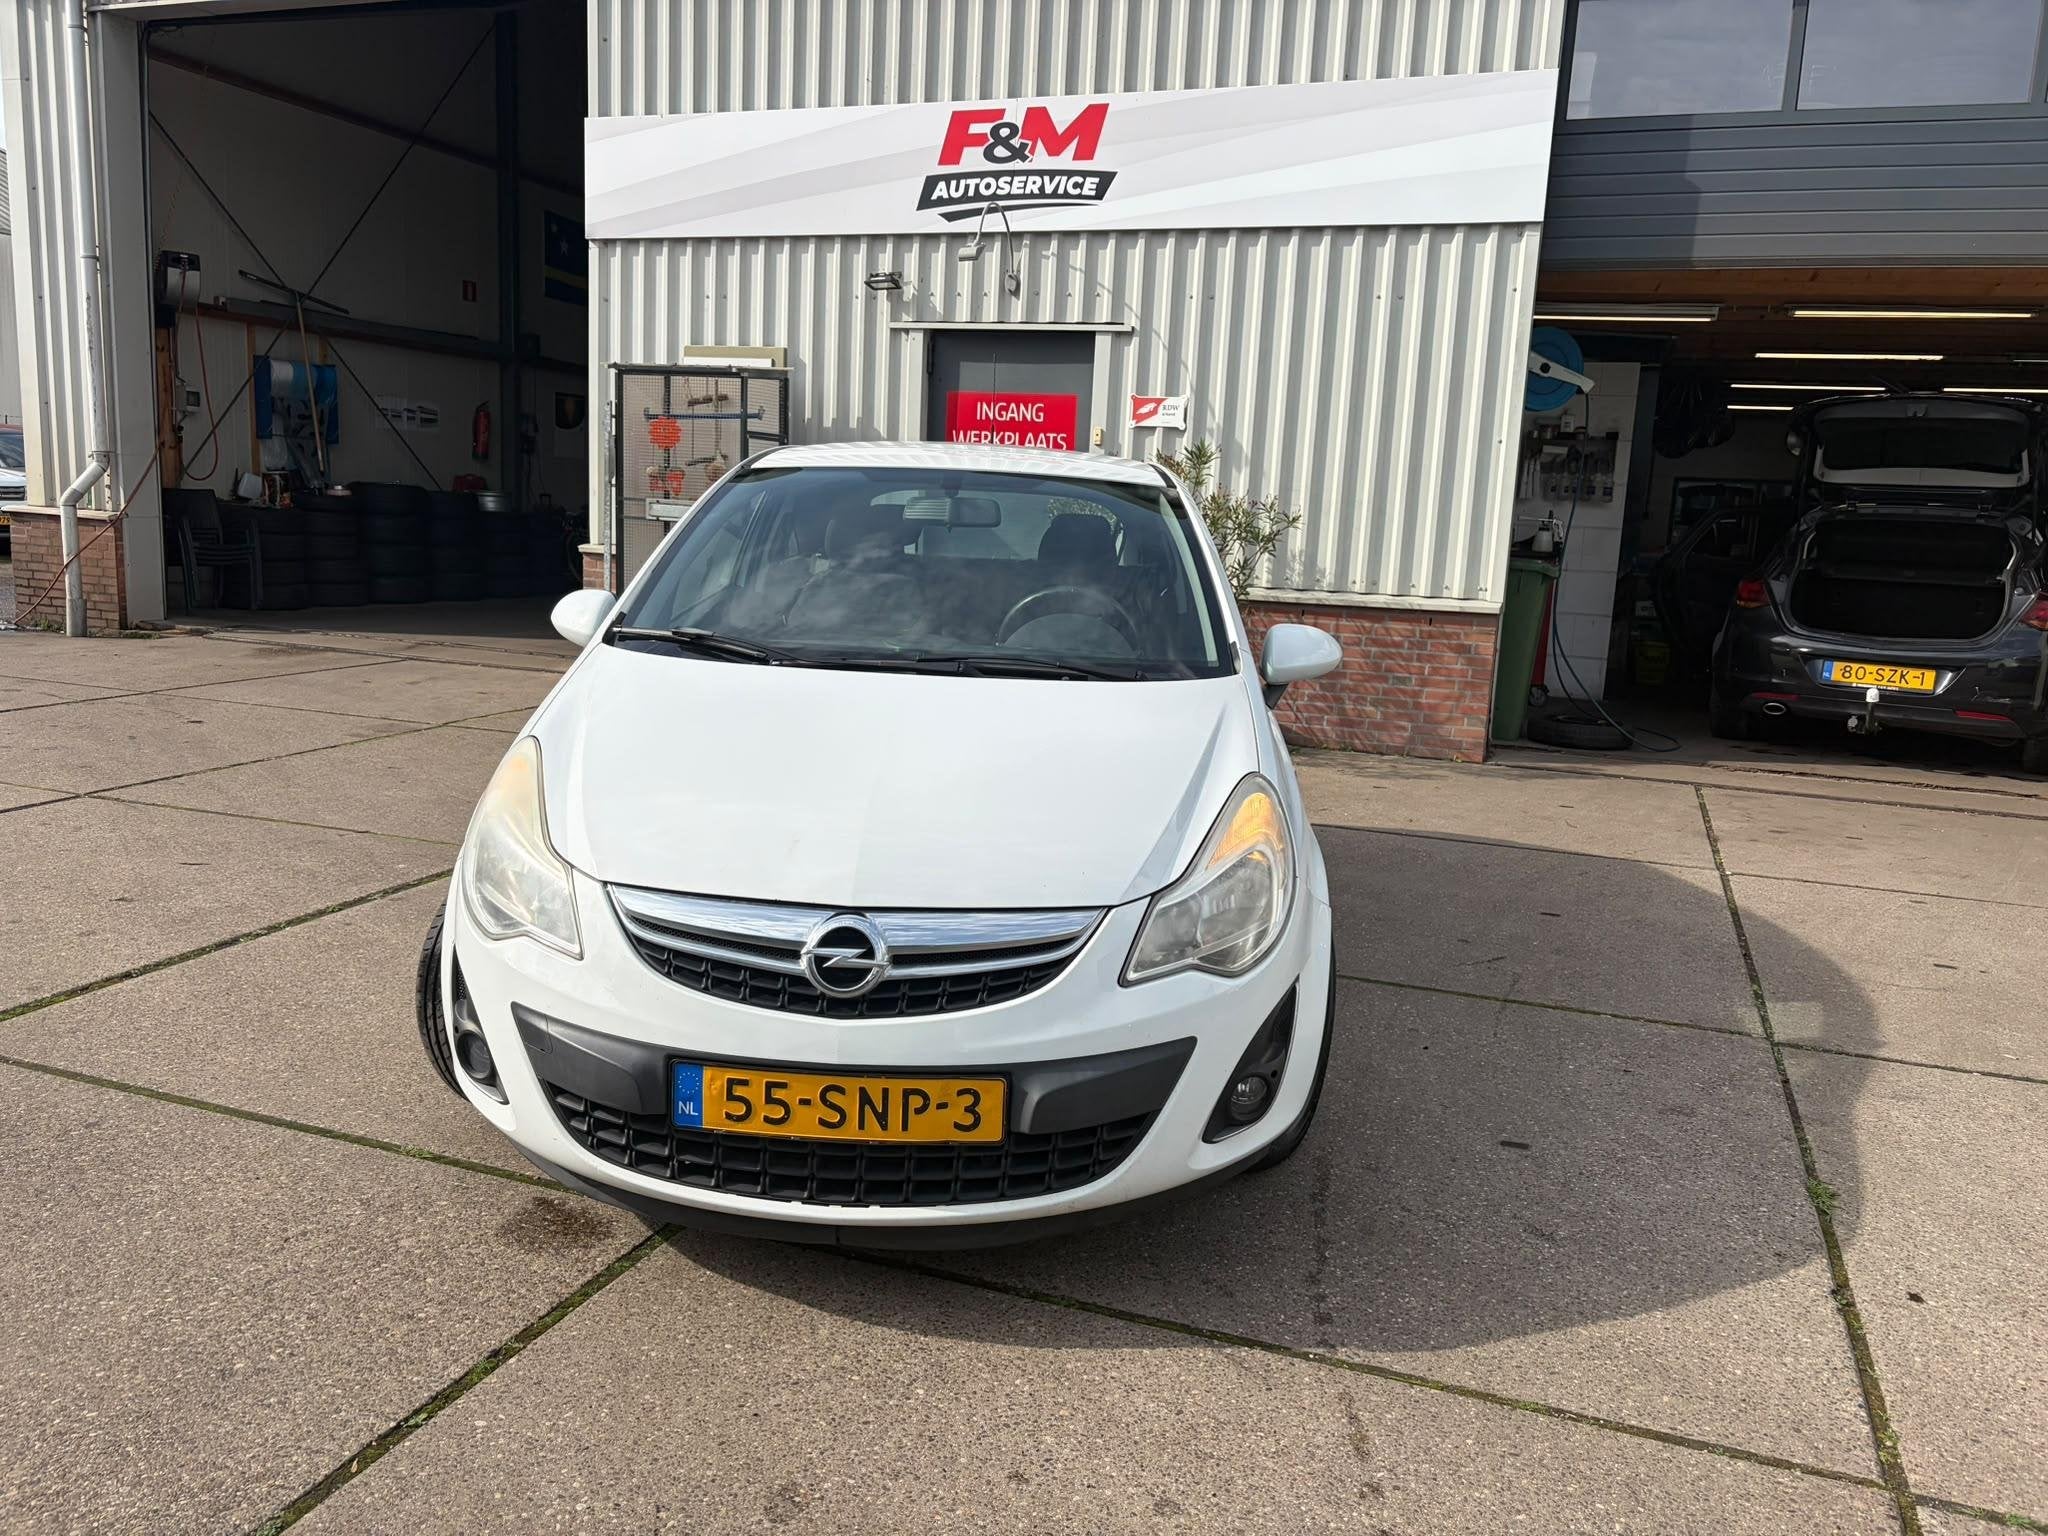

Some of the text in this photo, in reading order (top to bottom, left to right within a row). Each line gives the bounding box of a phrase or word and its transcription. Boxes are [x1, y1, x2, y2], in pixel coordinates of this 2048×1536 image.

[938, 103, 1110, 166] F&M
[931, 175, 1100, 200] AUTOSERVICE
[976, 401, 1045, 422] INGANG
[1841, 664, 1925, 687] 80-SZK-1
[678, 1101, 699, 1116] NL
[723, 1077, 982, 1133] 55-SNP-3
